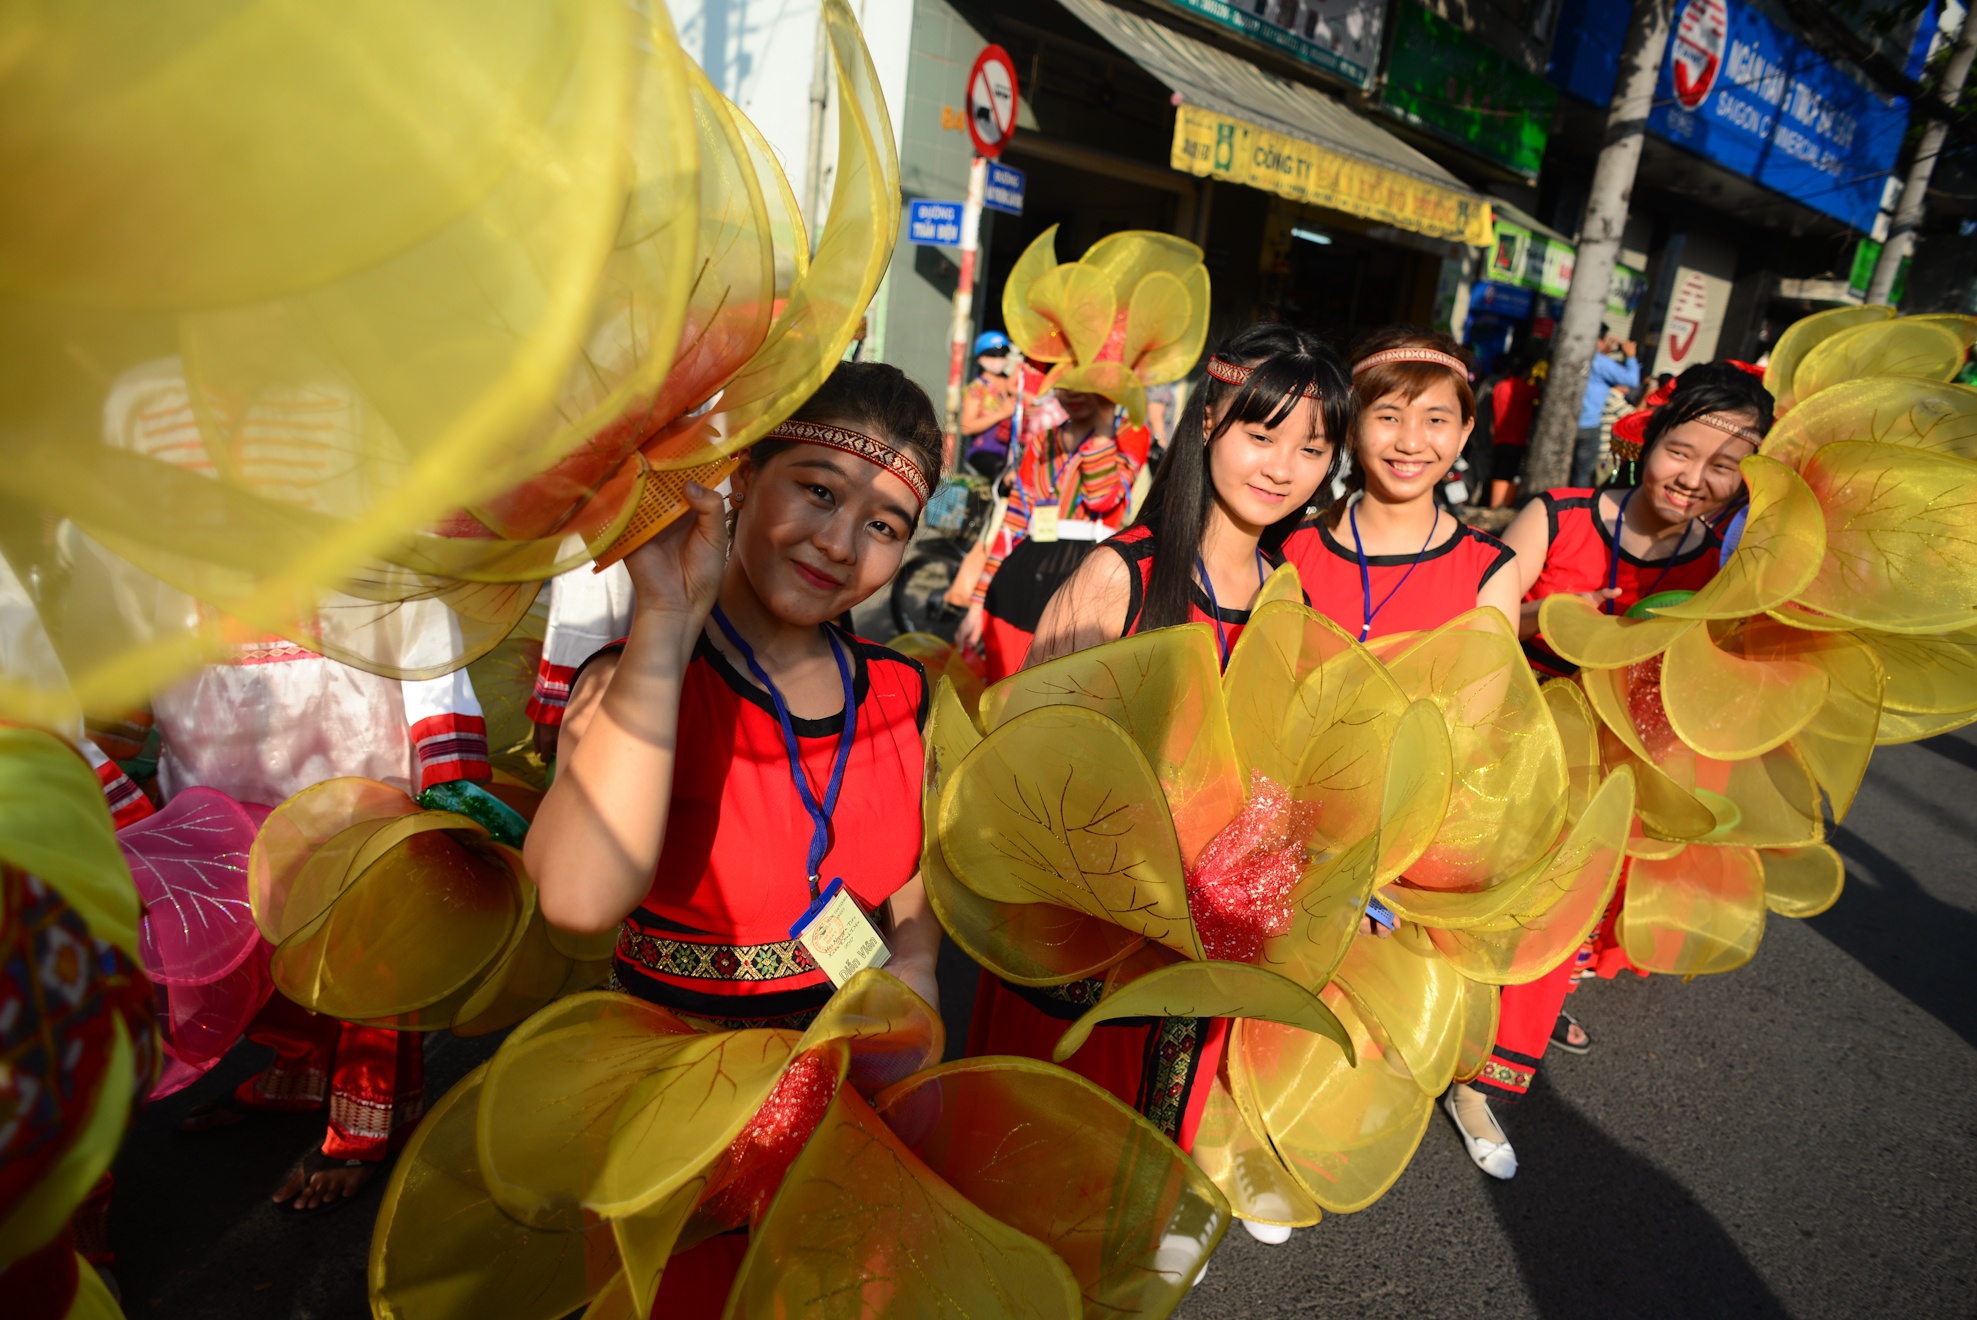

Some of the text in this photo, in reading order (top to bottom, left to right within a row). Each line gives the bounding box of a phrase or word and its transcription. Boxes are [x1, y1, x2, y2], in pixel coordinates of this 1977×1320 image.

[1254, 144, 1293, 175] CÔNG
[839, 936, 878, 982] Diễn Viên
